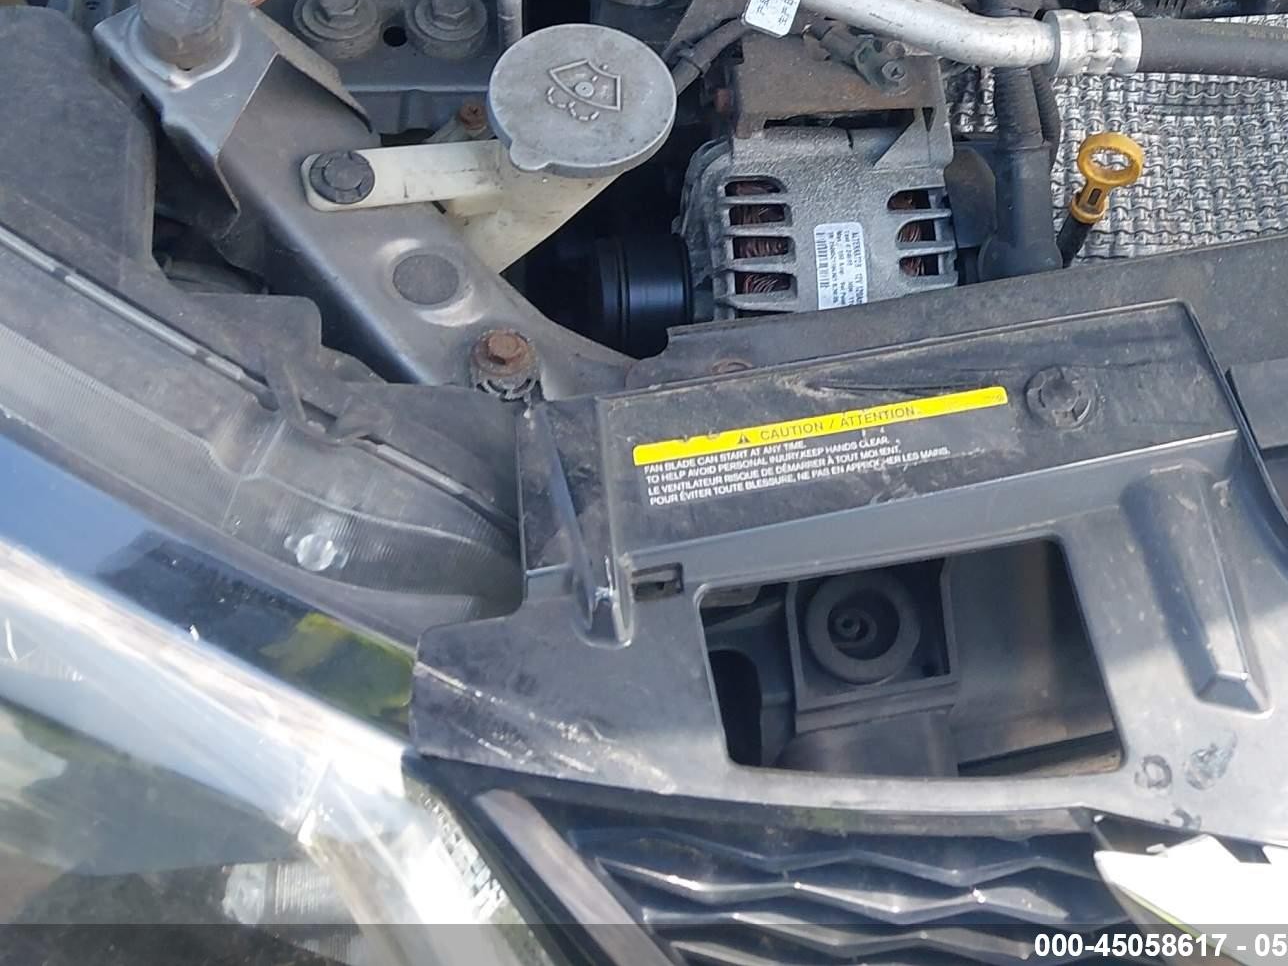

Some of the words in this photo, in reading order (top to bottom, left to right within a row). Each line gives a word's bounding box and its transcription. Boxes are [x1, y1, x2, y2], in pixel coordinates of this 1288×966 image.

[761, 421, 824, 441] CAUTION
[840, 406, 915, 426] ATTENTION
[644, 463, 663, 474] FAN
[665, 459, 696, 472] BLADE
[697, 455, 718, 467] CAN
[720, 450, 748, 463] START
[750, 447, 762, 458] AT
[763, 443, 782, 455] ANY
[646, 473, 660, 485] TO
[661, 468, 686, 482] HELP
[687, 464, 716, 478] AVOID
[718, 456, 768, 474] PERSONAL
[825, 441, 858, 453] HANDS
[648, 485, 660, 496] LE
[662, 474, 723, 494] VENTILATEUR
[724, 469, 760, 483] RISQUE
[761, 466, 774, 477] DE
[775, 456, 826, 475] DÉMARRER
[827, 452, 835, 465] À
[836, 450, 859, 464] TOUT
[650, 492, 679, 506] POUR
[680, 487, 712, 502] ÉVITER
[714, 483, 744, 496] TOUTE
[797, 470, 811, 482] NE
[811, 465, 831, 479] PAS
[832, 463, 844, 475] EN
[902, 452, 919, 464] LES
